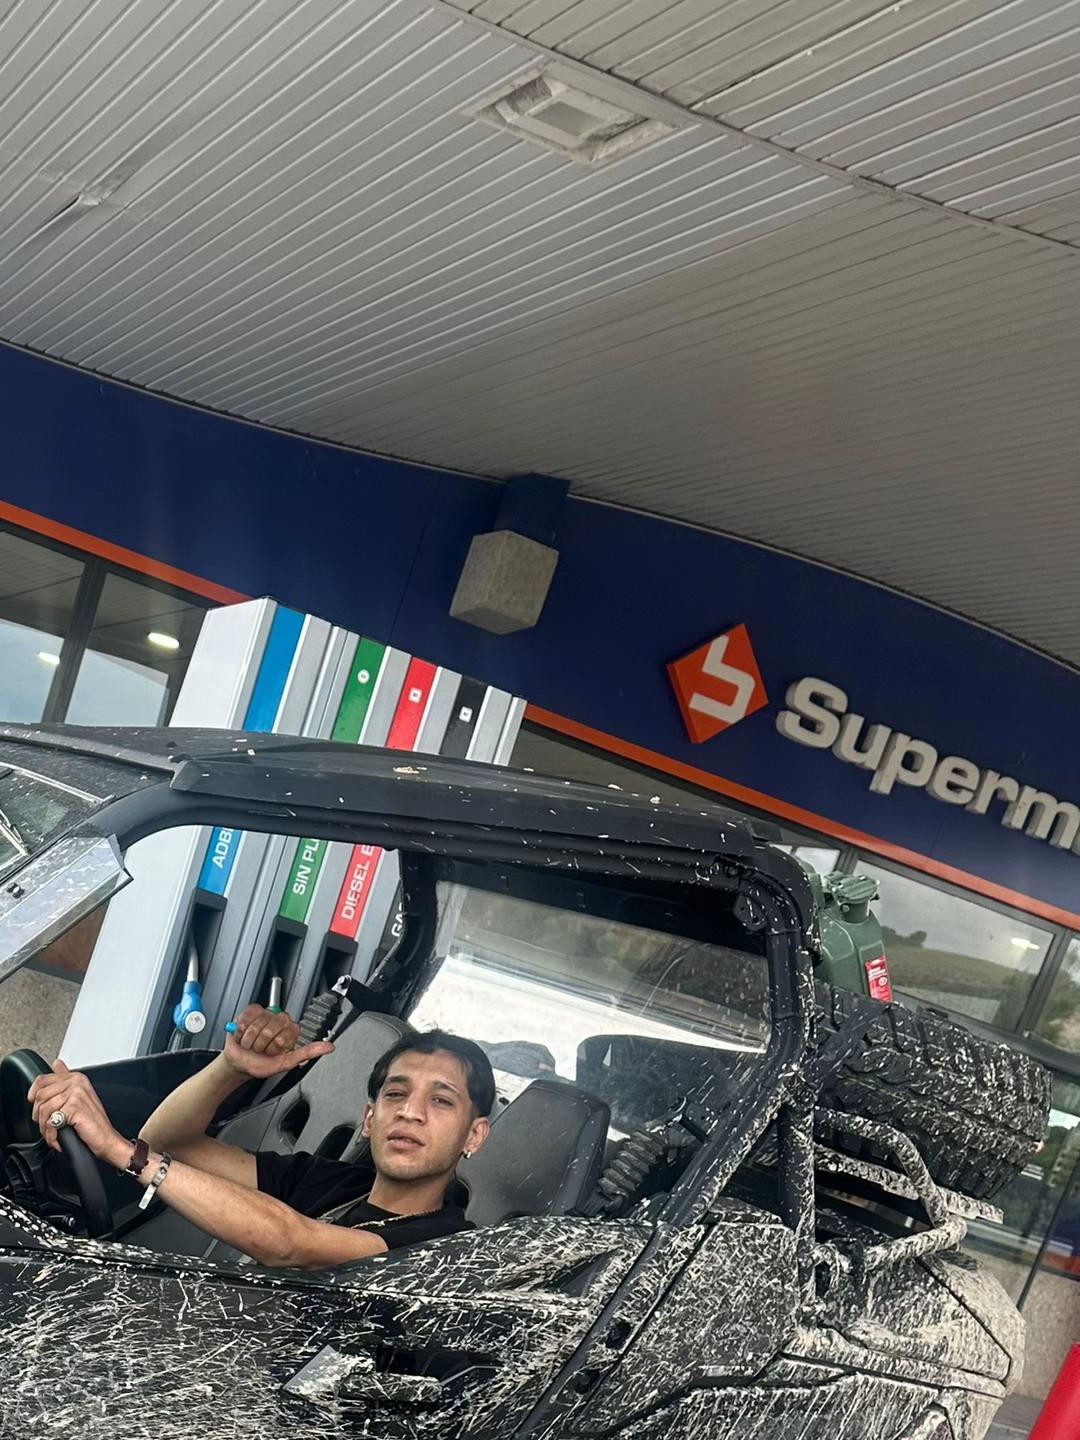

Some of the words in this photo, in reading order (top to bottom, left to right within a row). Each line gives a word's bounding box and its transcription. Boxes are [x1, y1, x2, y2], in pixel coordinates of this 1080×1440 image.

[776, 676, 1080, 855] Superm
[212, 827, 235, 868] ADB
[293, 865, 311, 895] SIN
[341, 859, 370, 920] DIESEL
